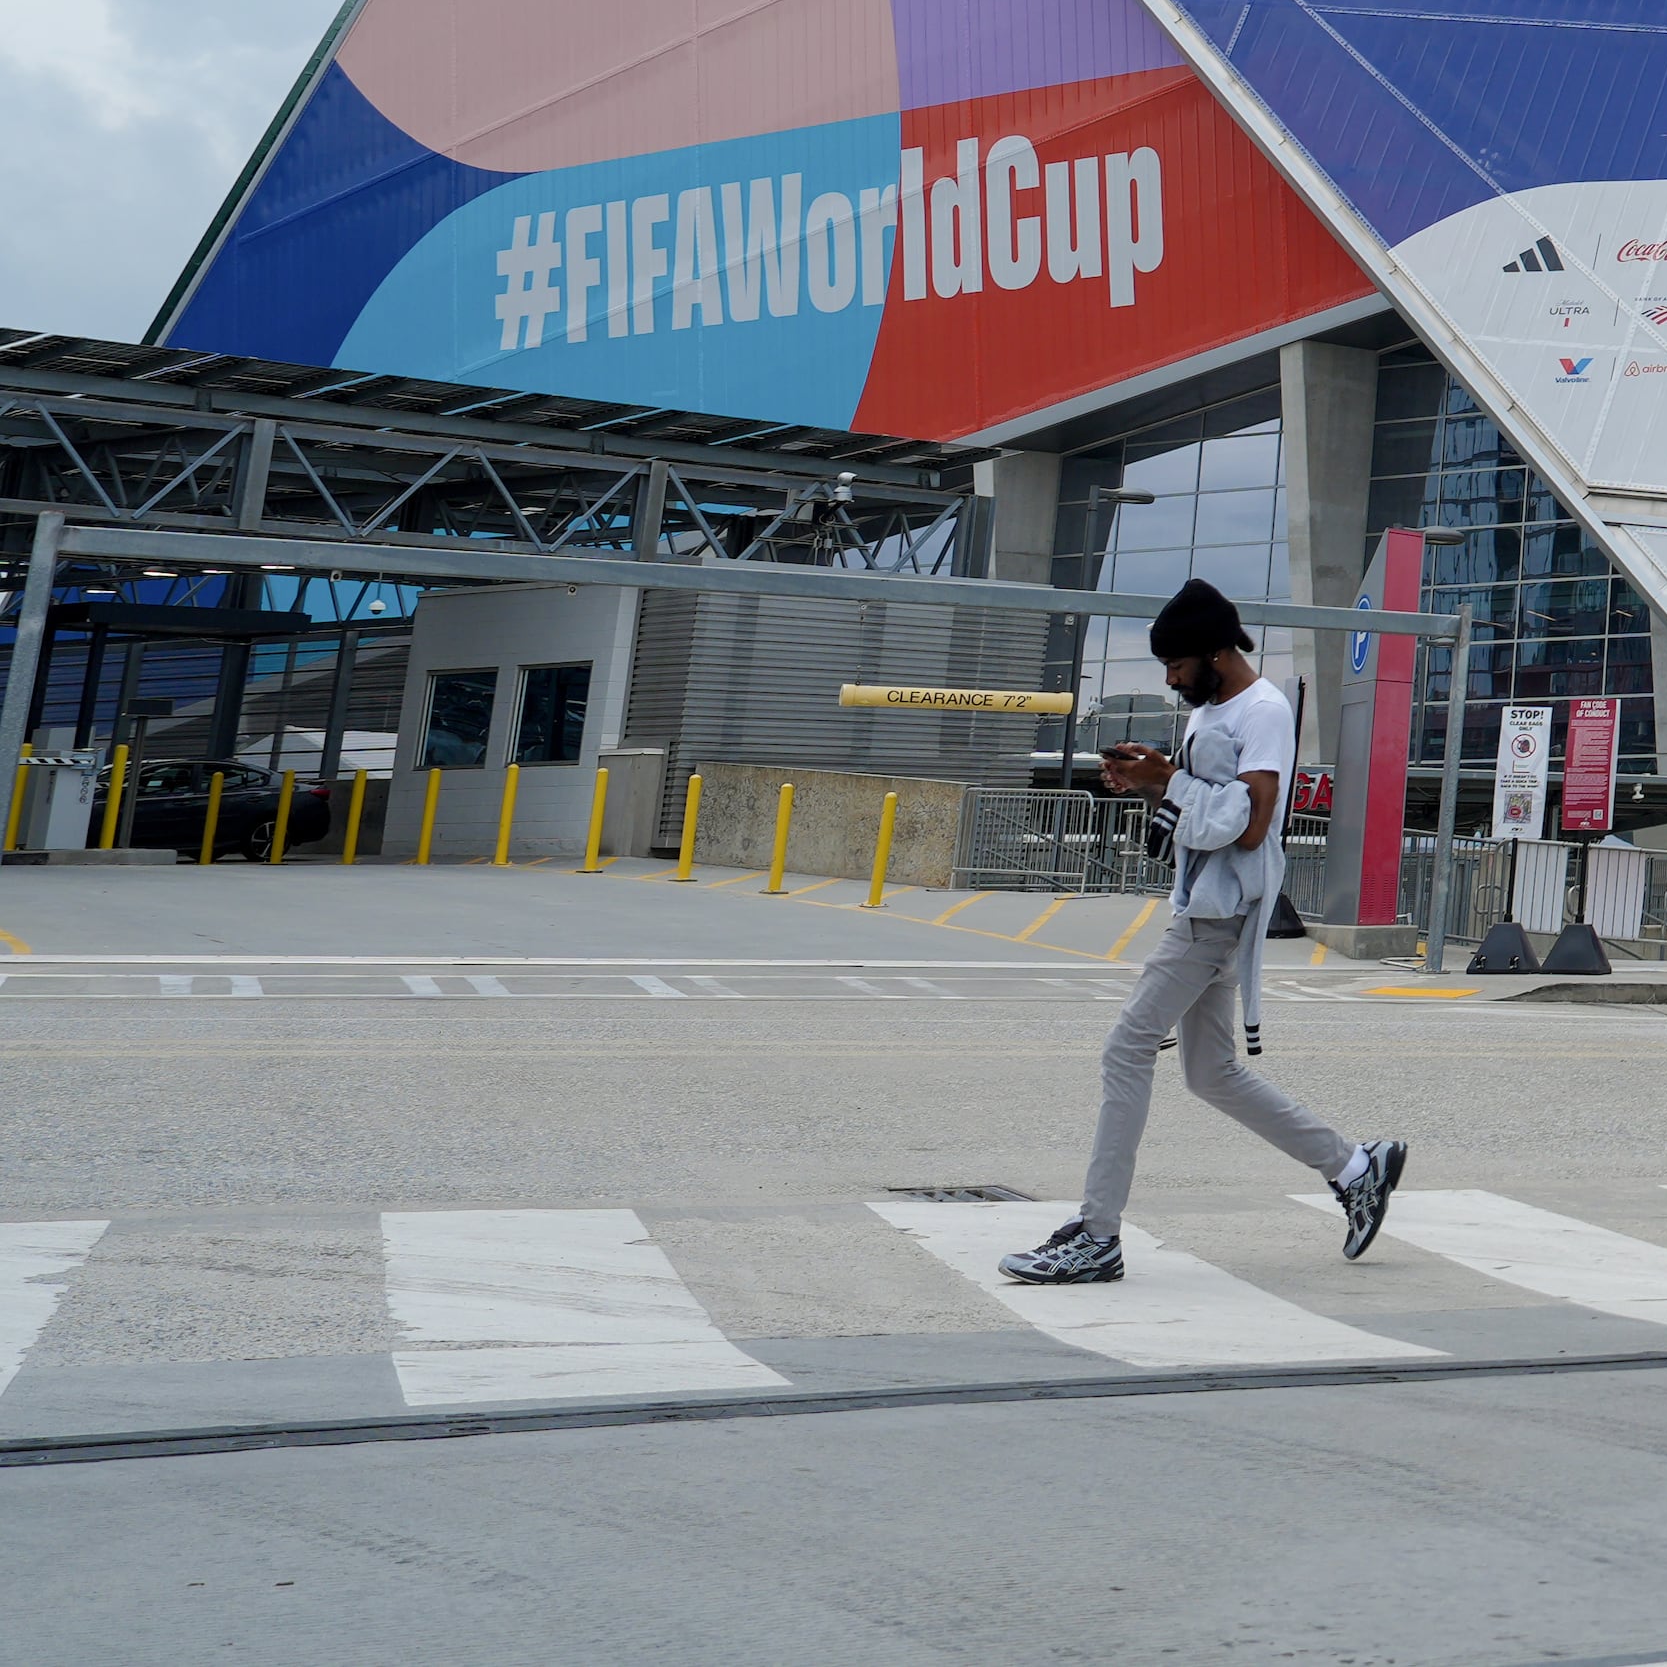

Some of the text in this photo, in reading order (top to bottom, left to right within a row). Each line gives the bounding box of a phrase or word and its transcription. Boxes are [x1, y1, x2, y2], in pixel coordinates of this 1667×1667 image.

[495, 135, 1165, 351] #FIFAWorldCup
[1550, 306, 1590, 315] ULTRA
[1555, 376, 1591, 384] Valvoline
[887, 690, 1032, 708] CLEARANCE 7'2"
[1580, 701, 1607, 709] FAN CODE
[1511, 710, 1544, 720] STOP!
[1576, 710, 1584, 718] OF
